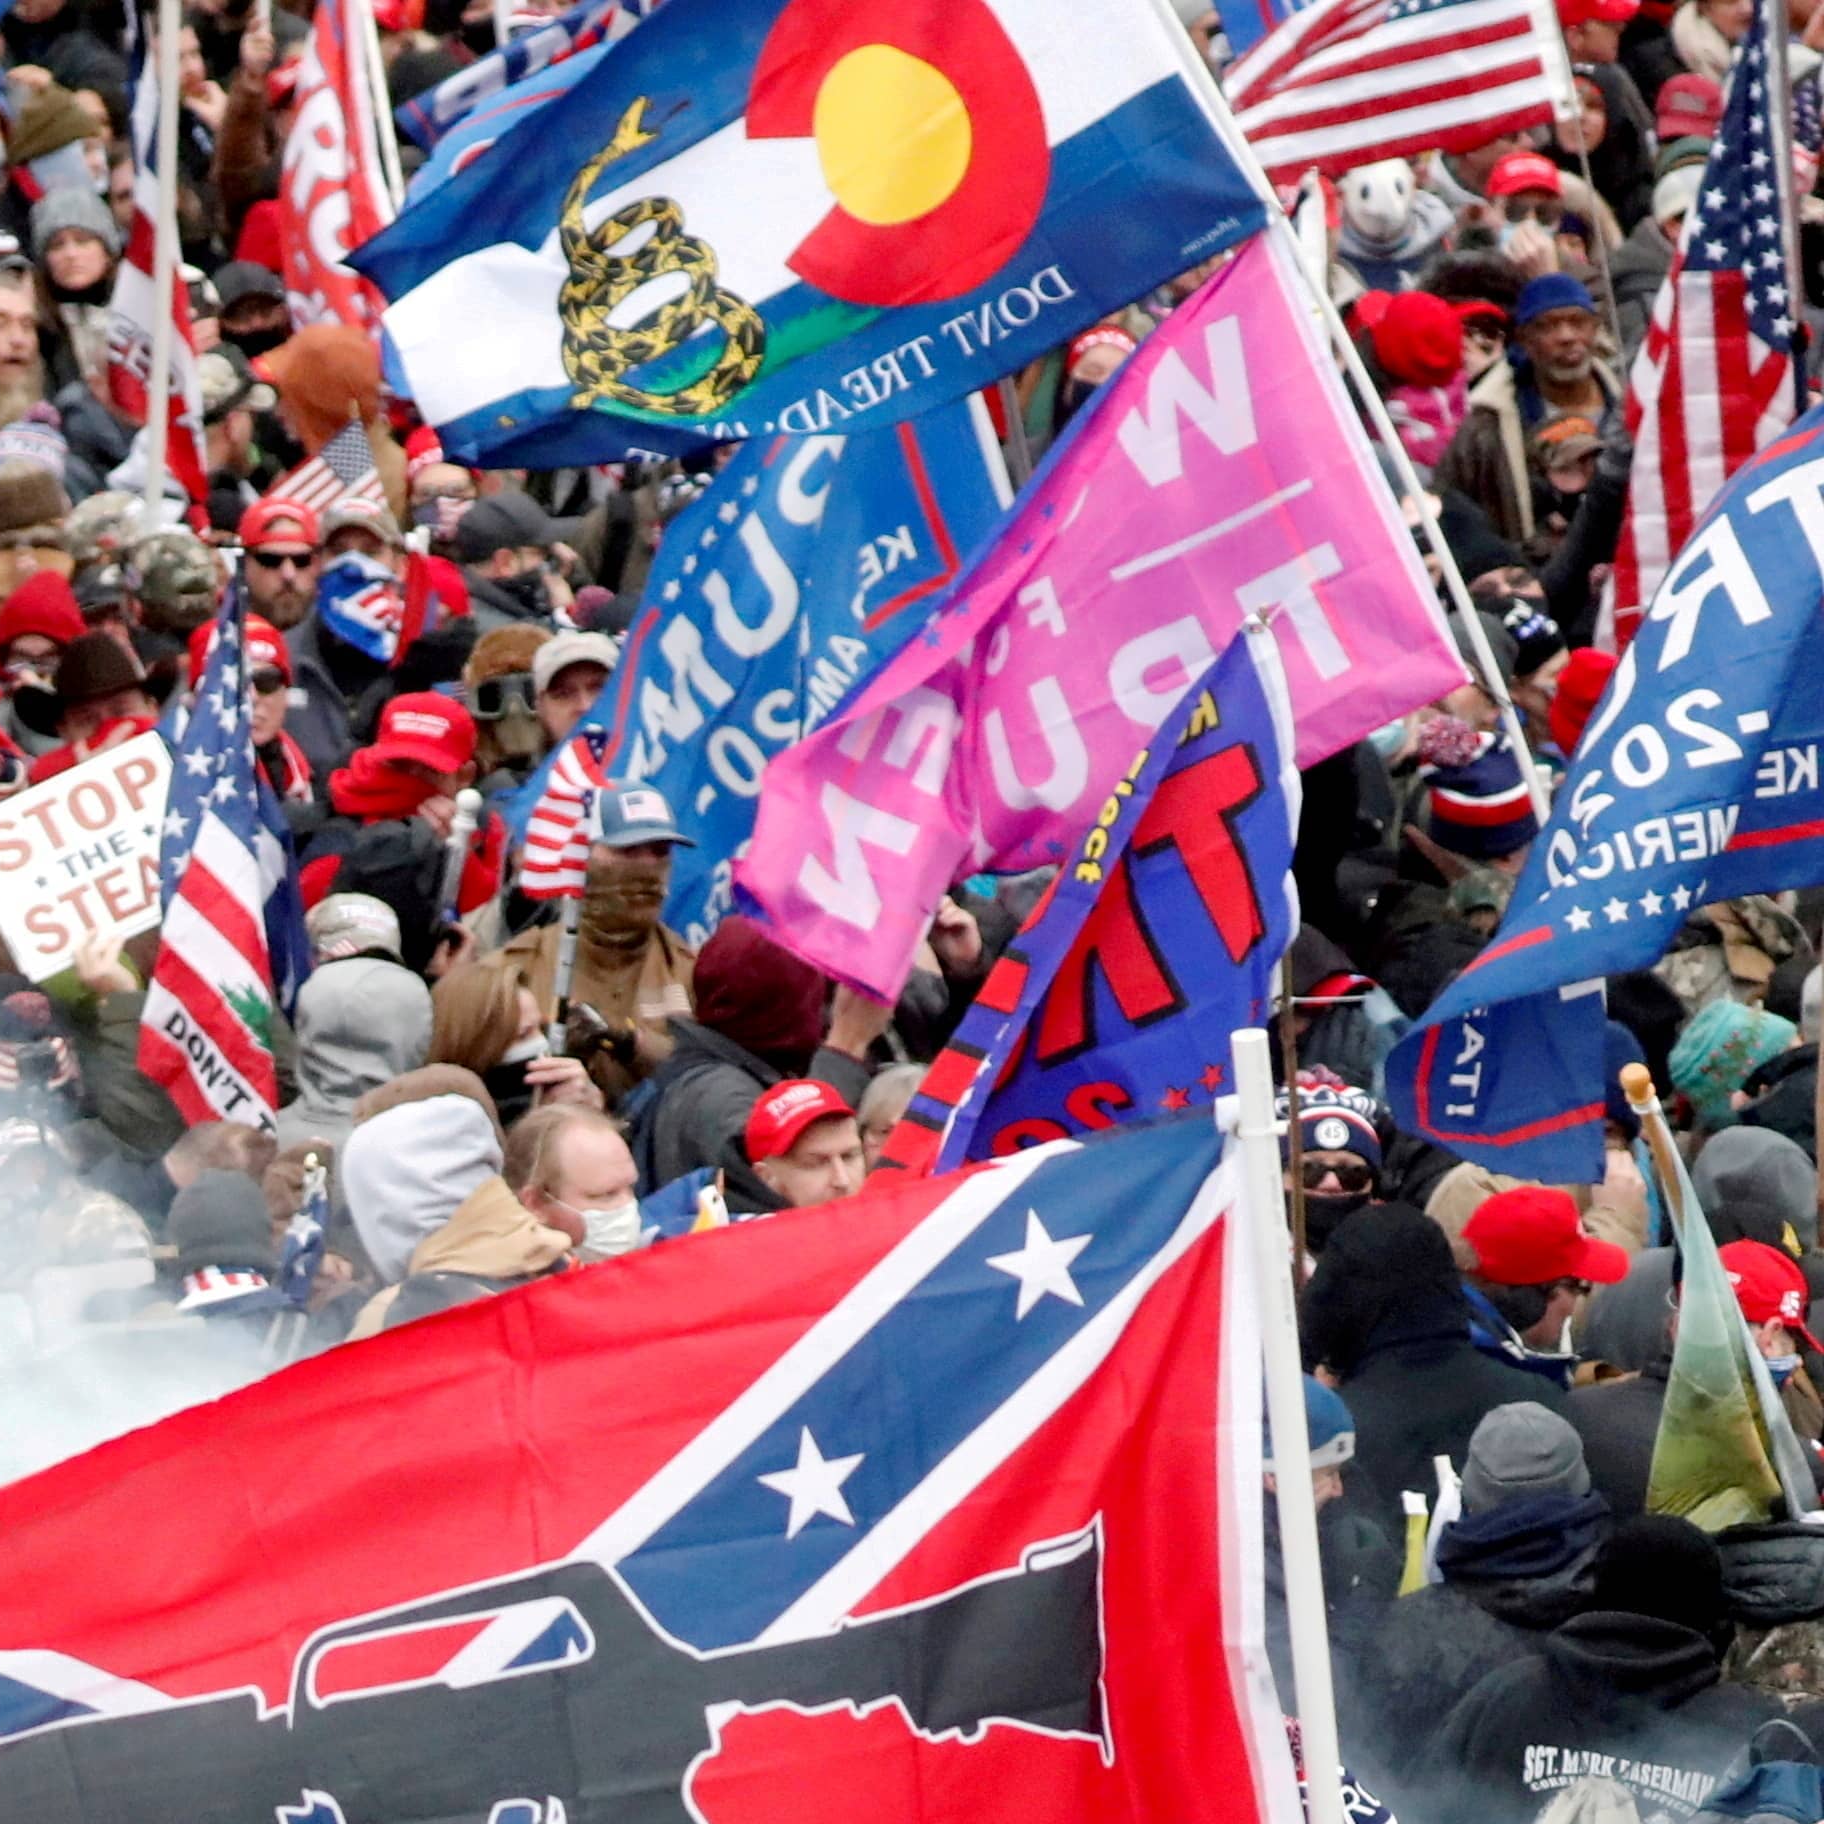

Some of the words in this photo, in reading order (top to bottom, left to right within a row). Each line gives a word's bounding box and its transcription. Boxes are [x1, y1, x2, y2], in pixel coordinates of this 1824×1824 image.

[58, 828, 135, 881] THE
[34, 855, 160, 955] STEA
[165, 1010, 251, 1114] DON'T
[1524, 1744, 1559, 1779] SGT.
